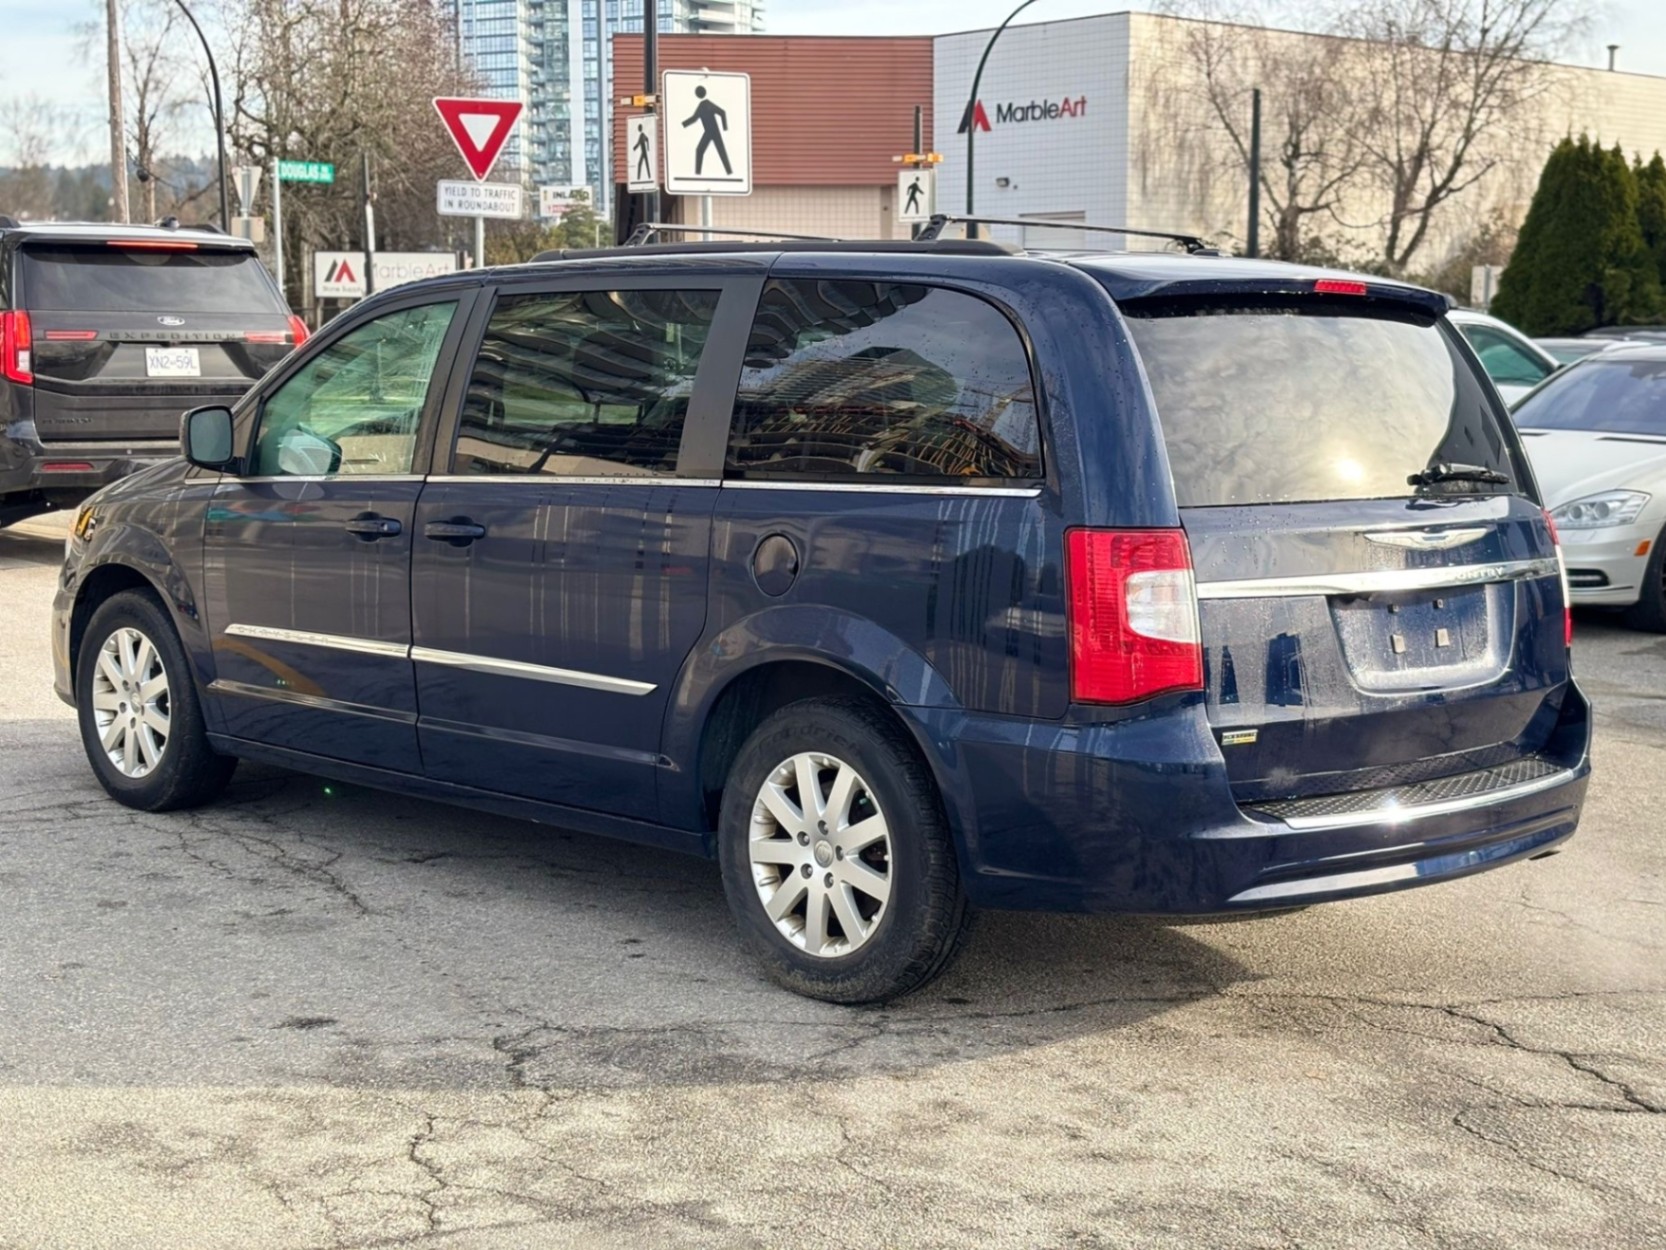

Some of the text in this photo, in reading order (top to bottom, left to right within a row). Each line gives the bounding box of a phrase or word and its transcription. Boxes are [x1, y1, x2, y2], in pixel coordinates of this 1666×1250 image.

[996, 95, 1087, 124] MarbleArt
[280, 162, 320, 180] DOUGLAS
[444, 186, 517, 200] YIELD TO TRAFFIC
[444, 199, 516, 214] IN ROUNDABOUT
[109, 331, 237, 340] EXPEDITION
